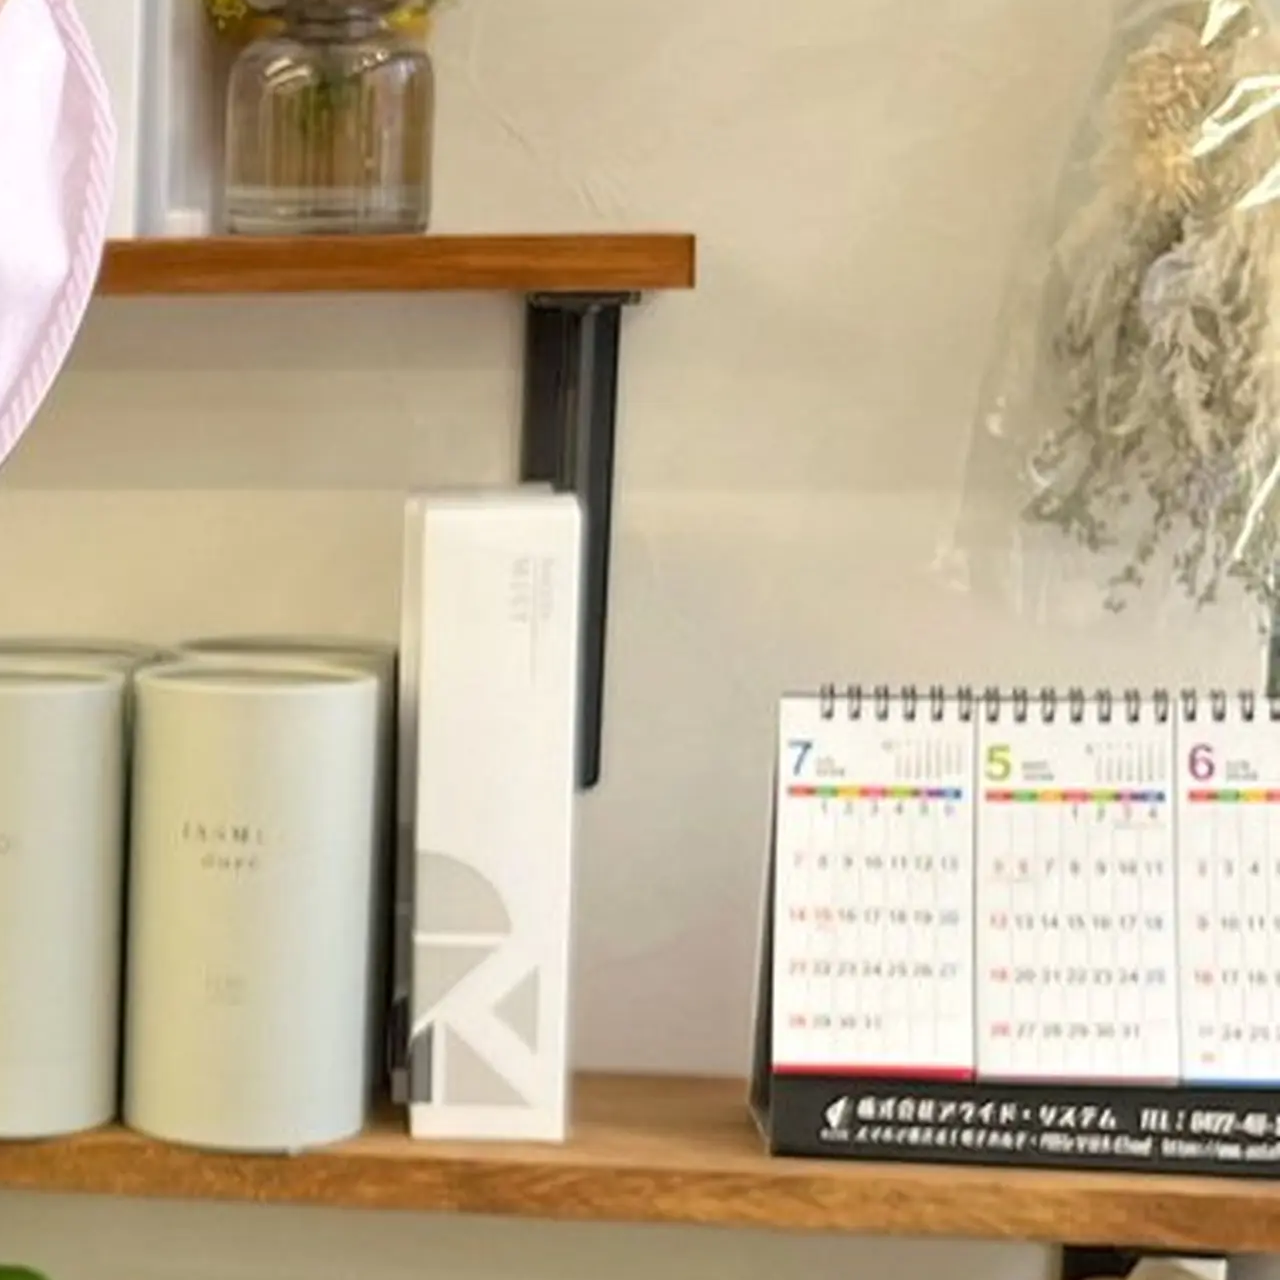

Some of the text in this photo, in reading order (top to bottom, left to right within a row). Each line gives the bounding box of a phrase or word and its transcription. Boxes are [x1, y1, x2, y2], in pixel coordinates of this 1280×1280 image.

[787, 738, 814, 777] 7
[984, 743, 1013, 782] 5
[1187, 742, 1217, 782] 6
